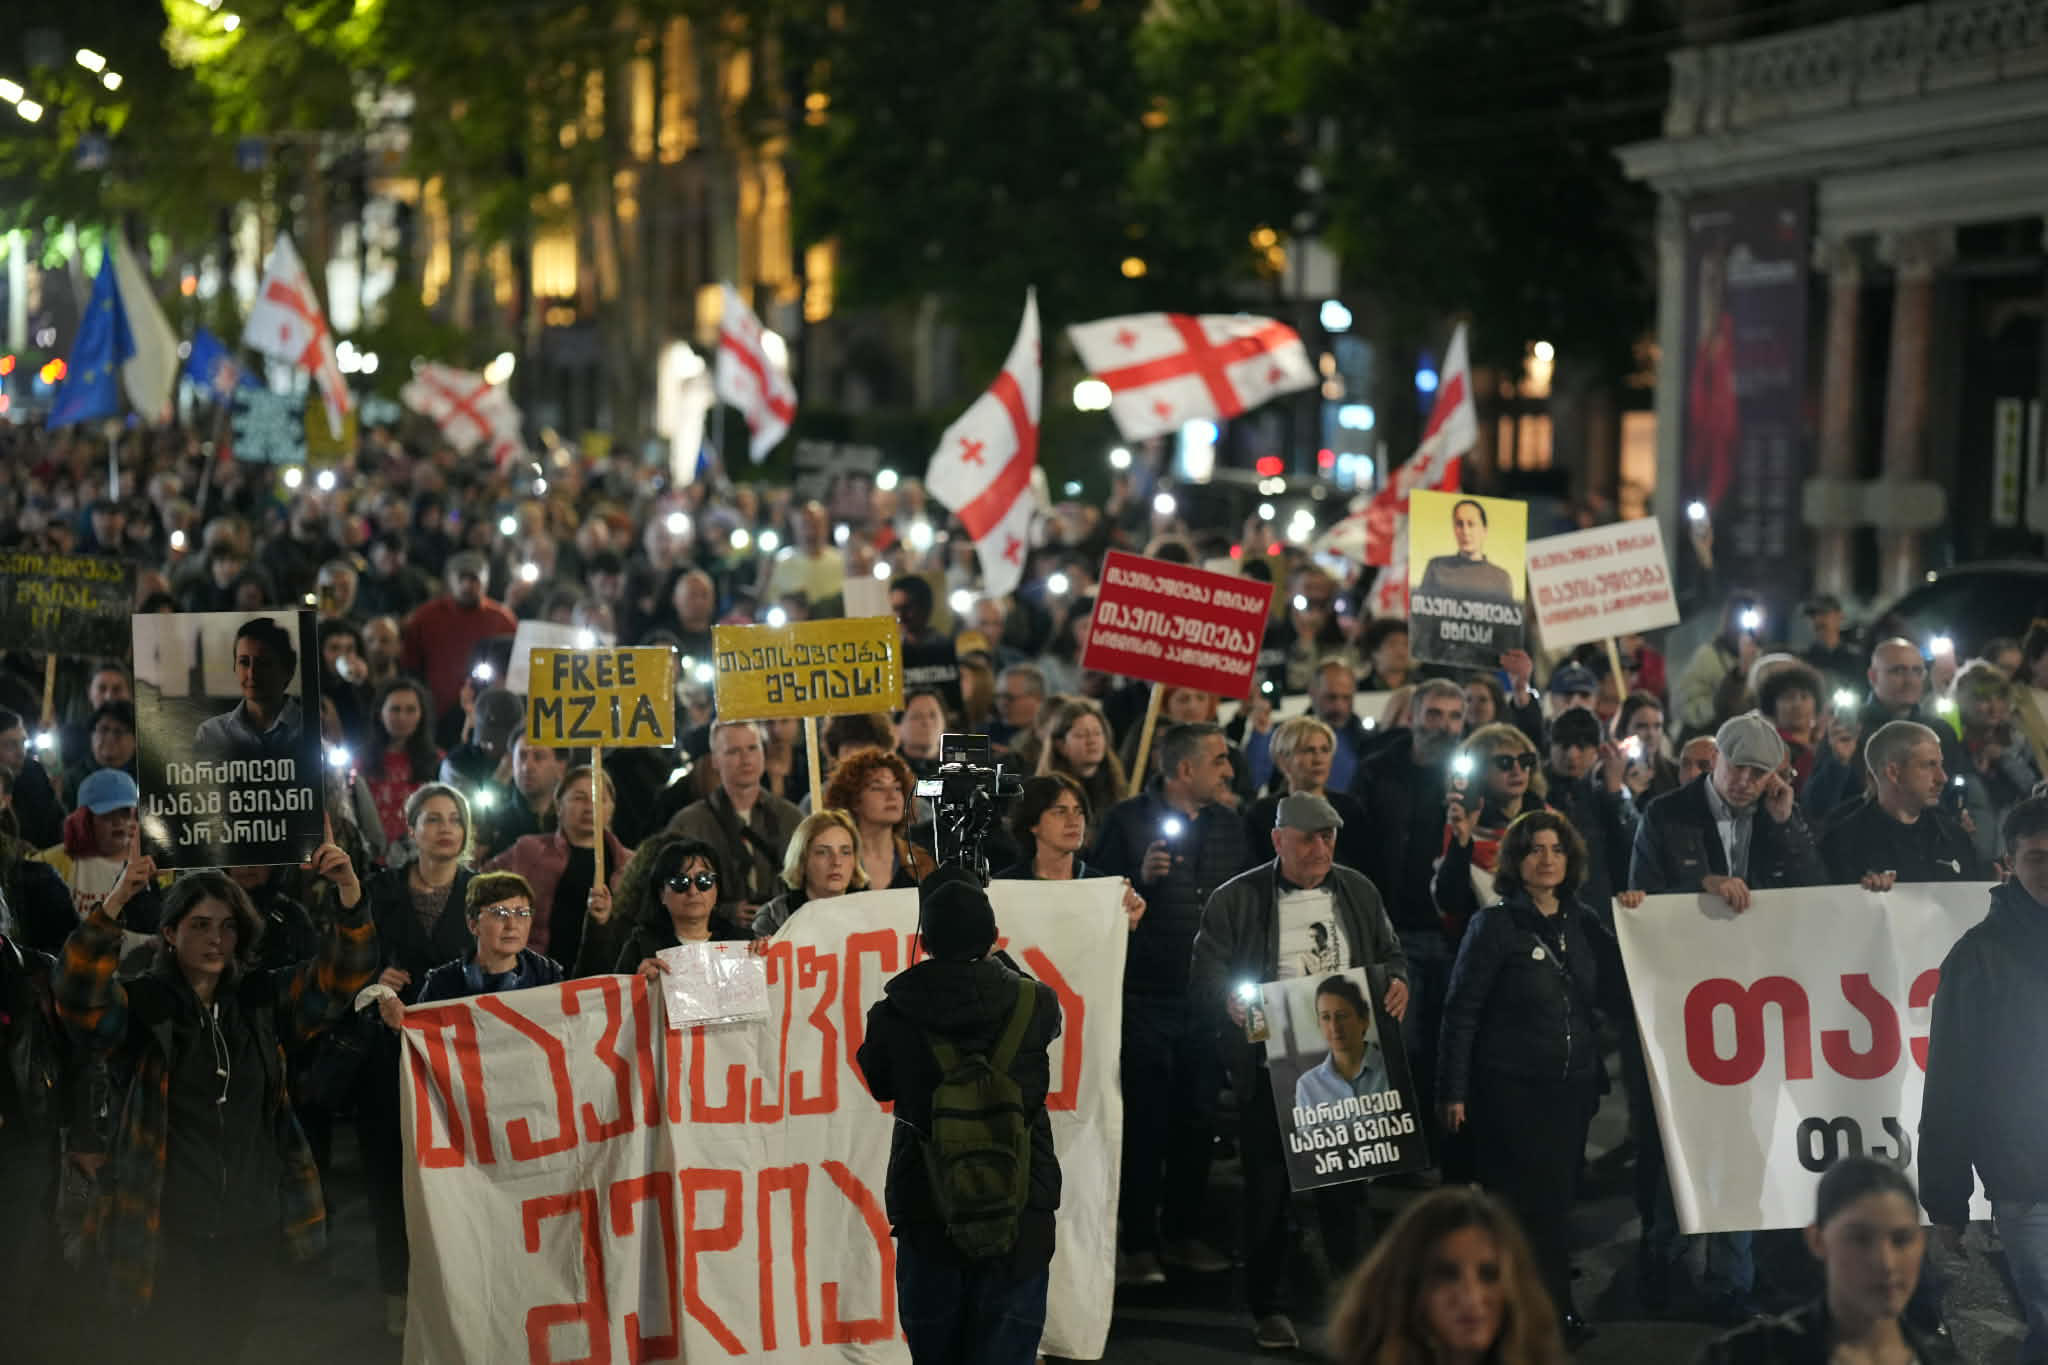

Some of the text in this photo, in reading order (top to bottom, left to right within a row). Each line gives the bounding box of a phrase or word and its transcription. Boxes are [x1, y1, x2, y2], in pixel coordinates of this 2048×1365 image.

[1098, 601, 1256, 655] თავისუფლება
[1411, 595, 1522, 625] თავისუფლება
[552, 653, 636, 691] FREE
[766, 667, 881, 704] მზიას!
[533, 693, 664, 739] MZIA
[166, 758, 296, 786] იბრძოლეთ
[149, 787, 314, 817] სანამ გვიანი
[179, 817, 287, 846] არ არის!
[1292, 1089, 1402, 1128] იბრძოლეთ
[1289, 1112, 1416, 1153] სანამ გვიან
[1314, 1141, 1401, 1175] არ არის
